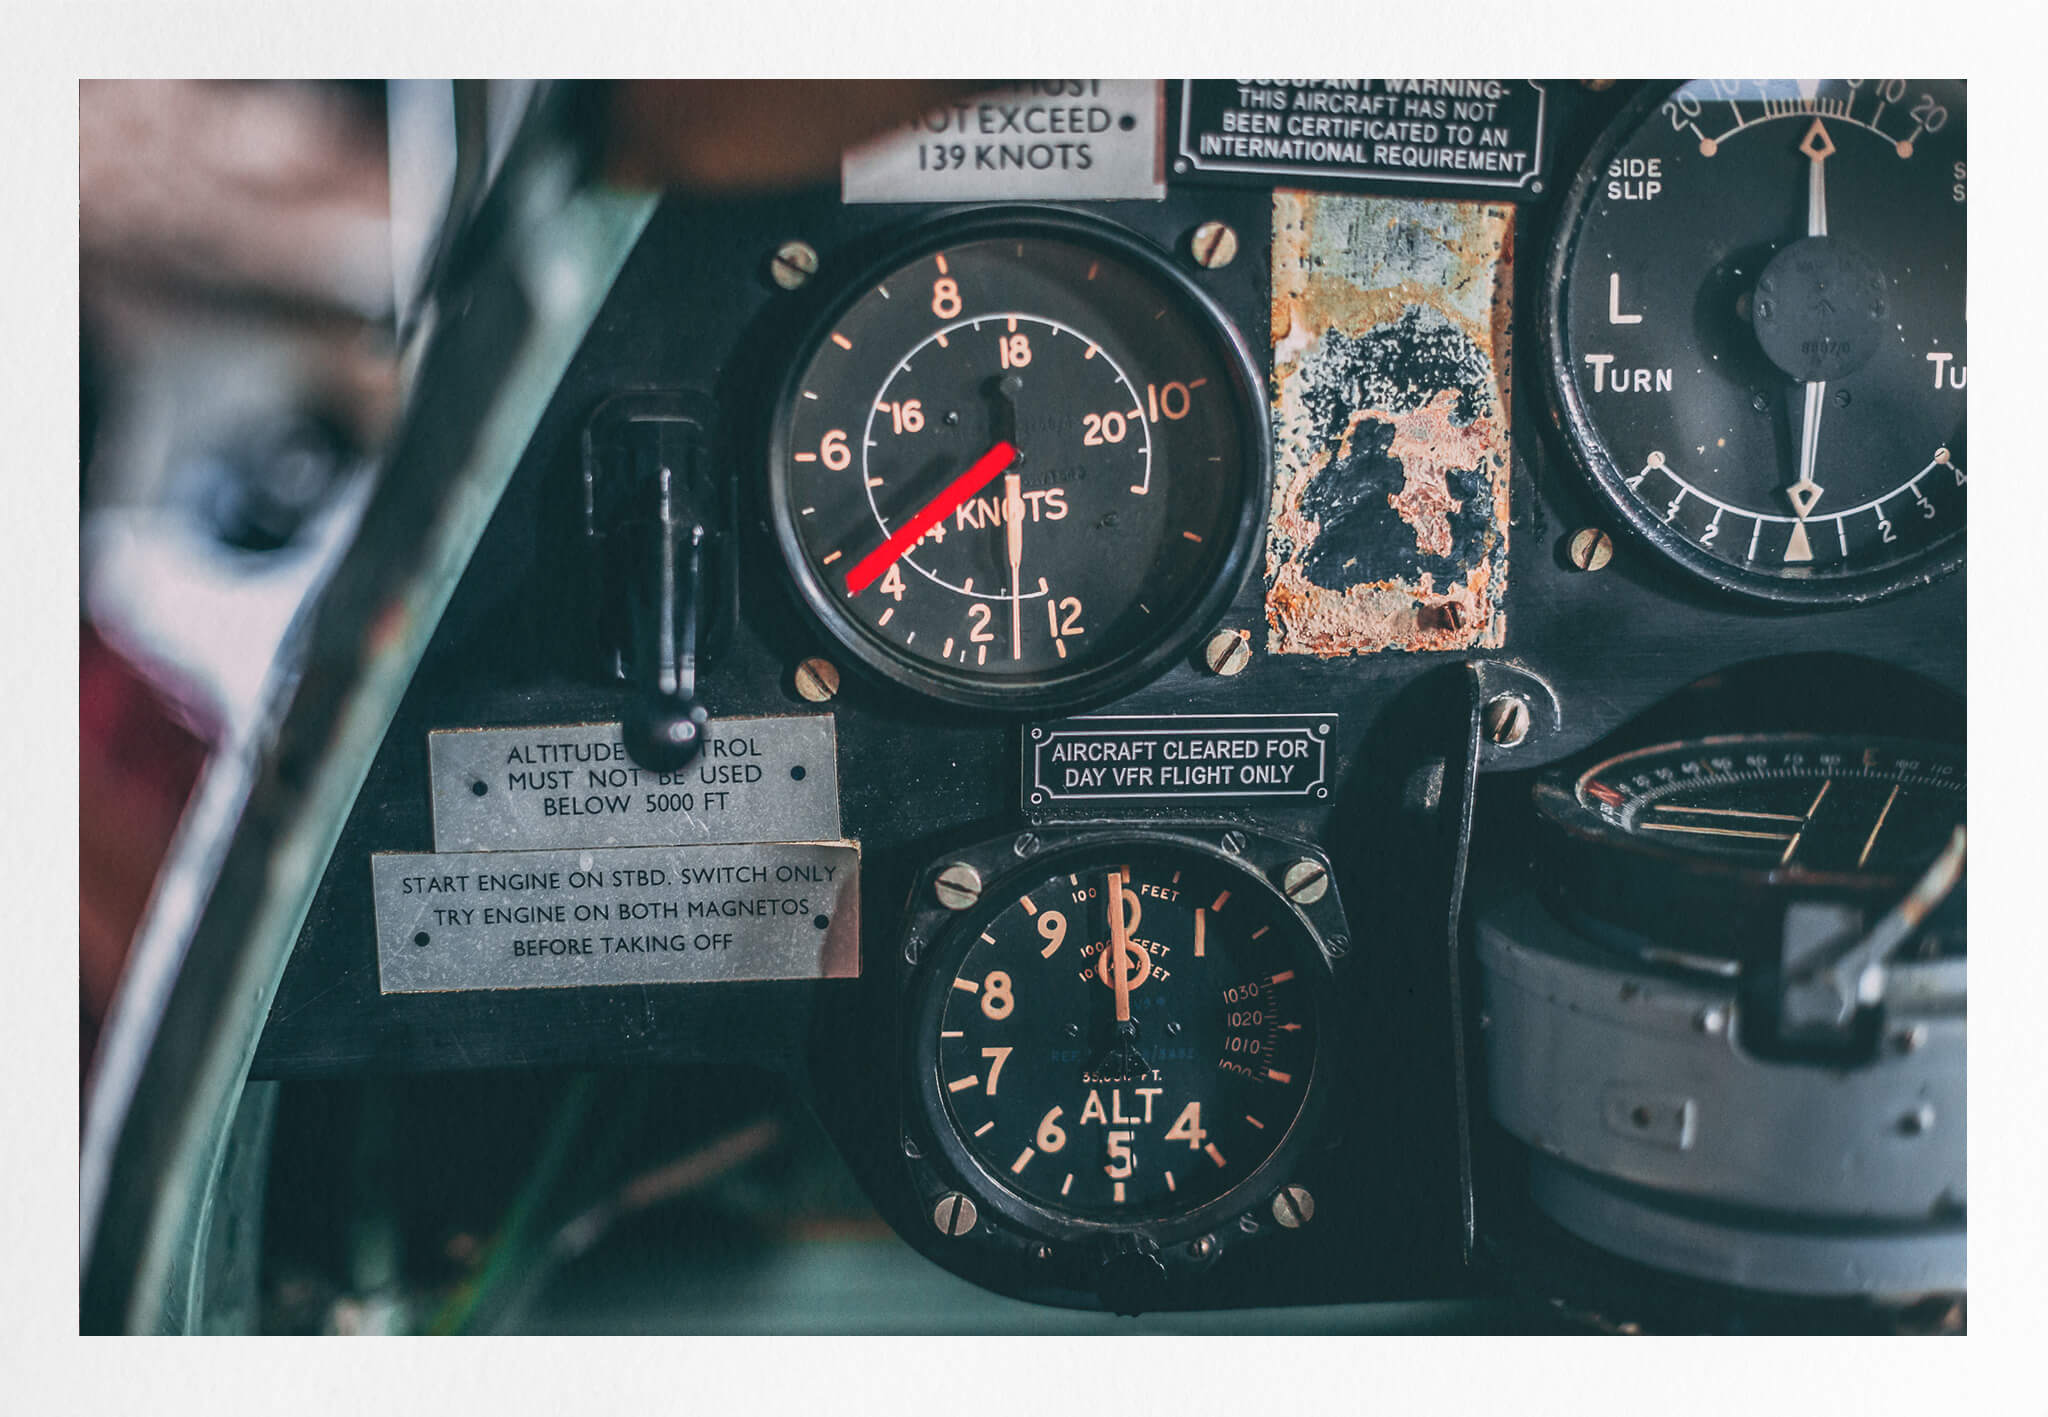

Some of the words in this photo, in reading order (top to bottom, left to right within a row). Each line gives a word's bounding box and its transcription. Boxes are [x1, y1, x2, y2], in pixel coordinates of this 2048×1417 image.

[978, 105, 1112, 135] EXCEED
[1237, 88, 1287, 110] THIS
[1293, 91, 1400, 118] AIRCRAFT
[1404, 99, 1446, 120] HAS
[1453, 101, 1497, 122] NOT
[1662, 90, 1701, 132] 20
[1910, 93, 1948, 133] 20
[1222, 111, 1282, 135] BEEN
[1287, 116, 1439, 144] CERTIFICATED
[1446, 126, 1472, 146] TO
[1479, 128, 1509, 148] AN
[919, 144, 966, 171] 139
[975, 143, 1093, 171] KNOTS
[1200, 135, 1367, 164] INTERNATIONAL
[1374, 145, 1527, 173] REQUIREMENT
[1608, 158, 1662, 178] SIDE
[1608, 181, 1662, 200] SLIP
[932, 278, 962, 319] 8
[1609, 272, 1642, 324] L
[1000, 333, 1031, 369] 18
[891, 400, 925, 434] 16
[1148, 381, 1191, 422] 10
[1083, 412, 1126, 446] 20
[821, 429, 851, 471] 6
[956, 488, 1068, 531] KNOTS
[1917, 497, 1936, 520] 3
[1699, 524, 1719, 547] 2
[1878, 520, 1897, 545] 2
[881, 563, 906, 601] 4
[968, 603, 994, 642] 2
[1048, 597, 1084, 638] 12
[507, 743, 626, 765] ALTITUDE
[701, 738, 762, 759] TROL
[1051, 741, 1157, 762] AIRCRAFT
[1163, 740, 1259, 760] CLEARED
[1265, 739, 1309, 758] FOR
[508, 770, 573, 791] MUST
[589, 768, 642, 788] NOT
[658, 772, 686, 786] BE
[700, 764, 762, 784] USED
[1065, 767, 1107, 788] DAY
[1112, 766, 1153, 787] VFR
[1160, 765, 1235, 786] FLIGHT
[1239, 764, 1295, 785] ONLY
[544, 795, 631, 817] BELOW
[646, 792, 694, 813] 5000
[704, 792, 730, 811] FT
[402, 875, 470, 894] START
[478, 872, 561, 891] ENGINE
[568, 871, 603, 889] ON
[612, 869, 672, 887] STBD.
[682, 866, 767, 885] SWITCH
[776, 865, 837, 882] ONLY
[1072, 888, 1097, 904] 100
[1141, 884, 1181, 902] FEET
[433, 909, 475, 926] TRY
[483, 905, 566, 924] ENGINE
[574, 904, 609, 922] ON
[619, 903, 678, 920] BOTH
[688, 899, 809, 918] MAGNETOS
[513, 937, 593, 957] BEFORE
[600, 935, 685, 954] TAKING
[694, 933, 733, 951] OFF
[1037, 910, 1067, 959] 9
[1194, 908, 1206, 957] 1
[981, 971, 1015, 1020] 8
[1223, 982, 1259, 1004] 1030
[1227, 1010, 1263, 1028] 1020
[1225, 1036, 1260, 1055] 1010
[981, 1047, 1014, 1096] 7
[1080, 1088, 1163, 1125] ALT
[1036, 1106, 1066, 1153] 6
[1165, 1101, 1206, 1149] 4
[1104, 1131, 1136, 1179] 5
